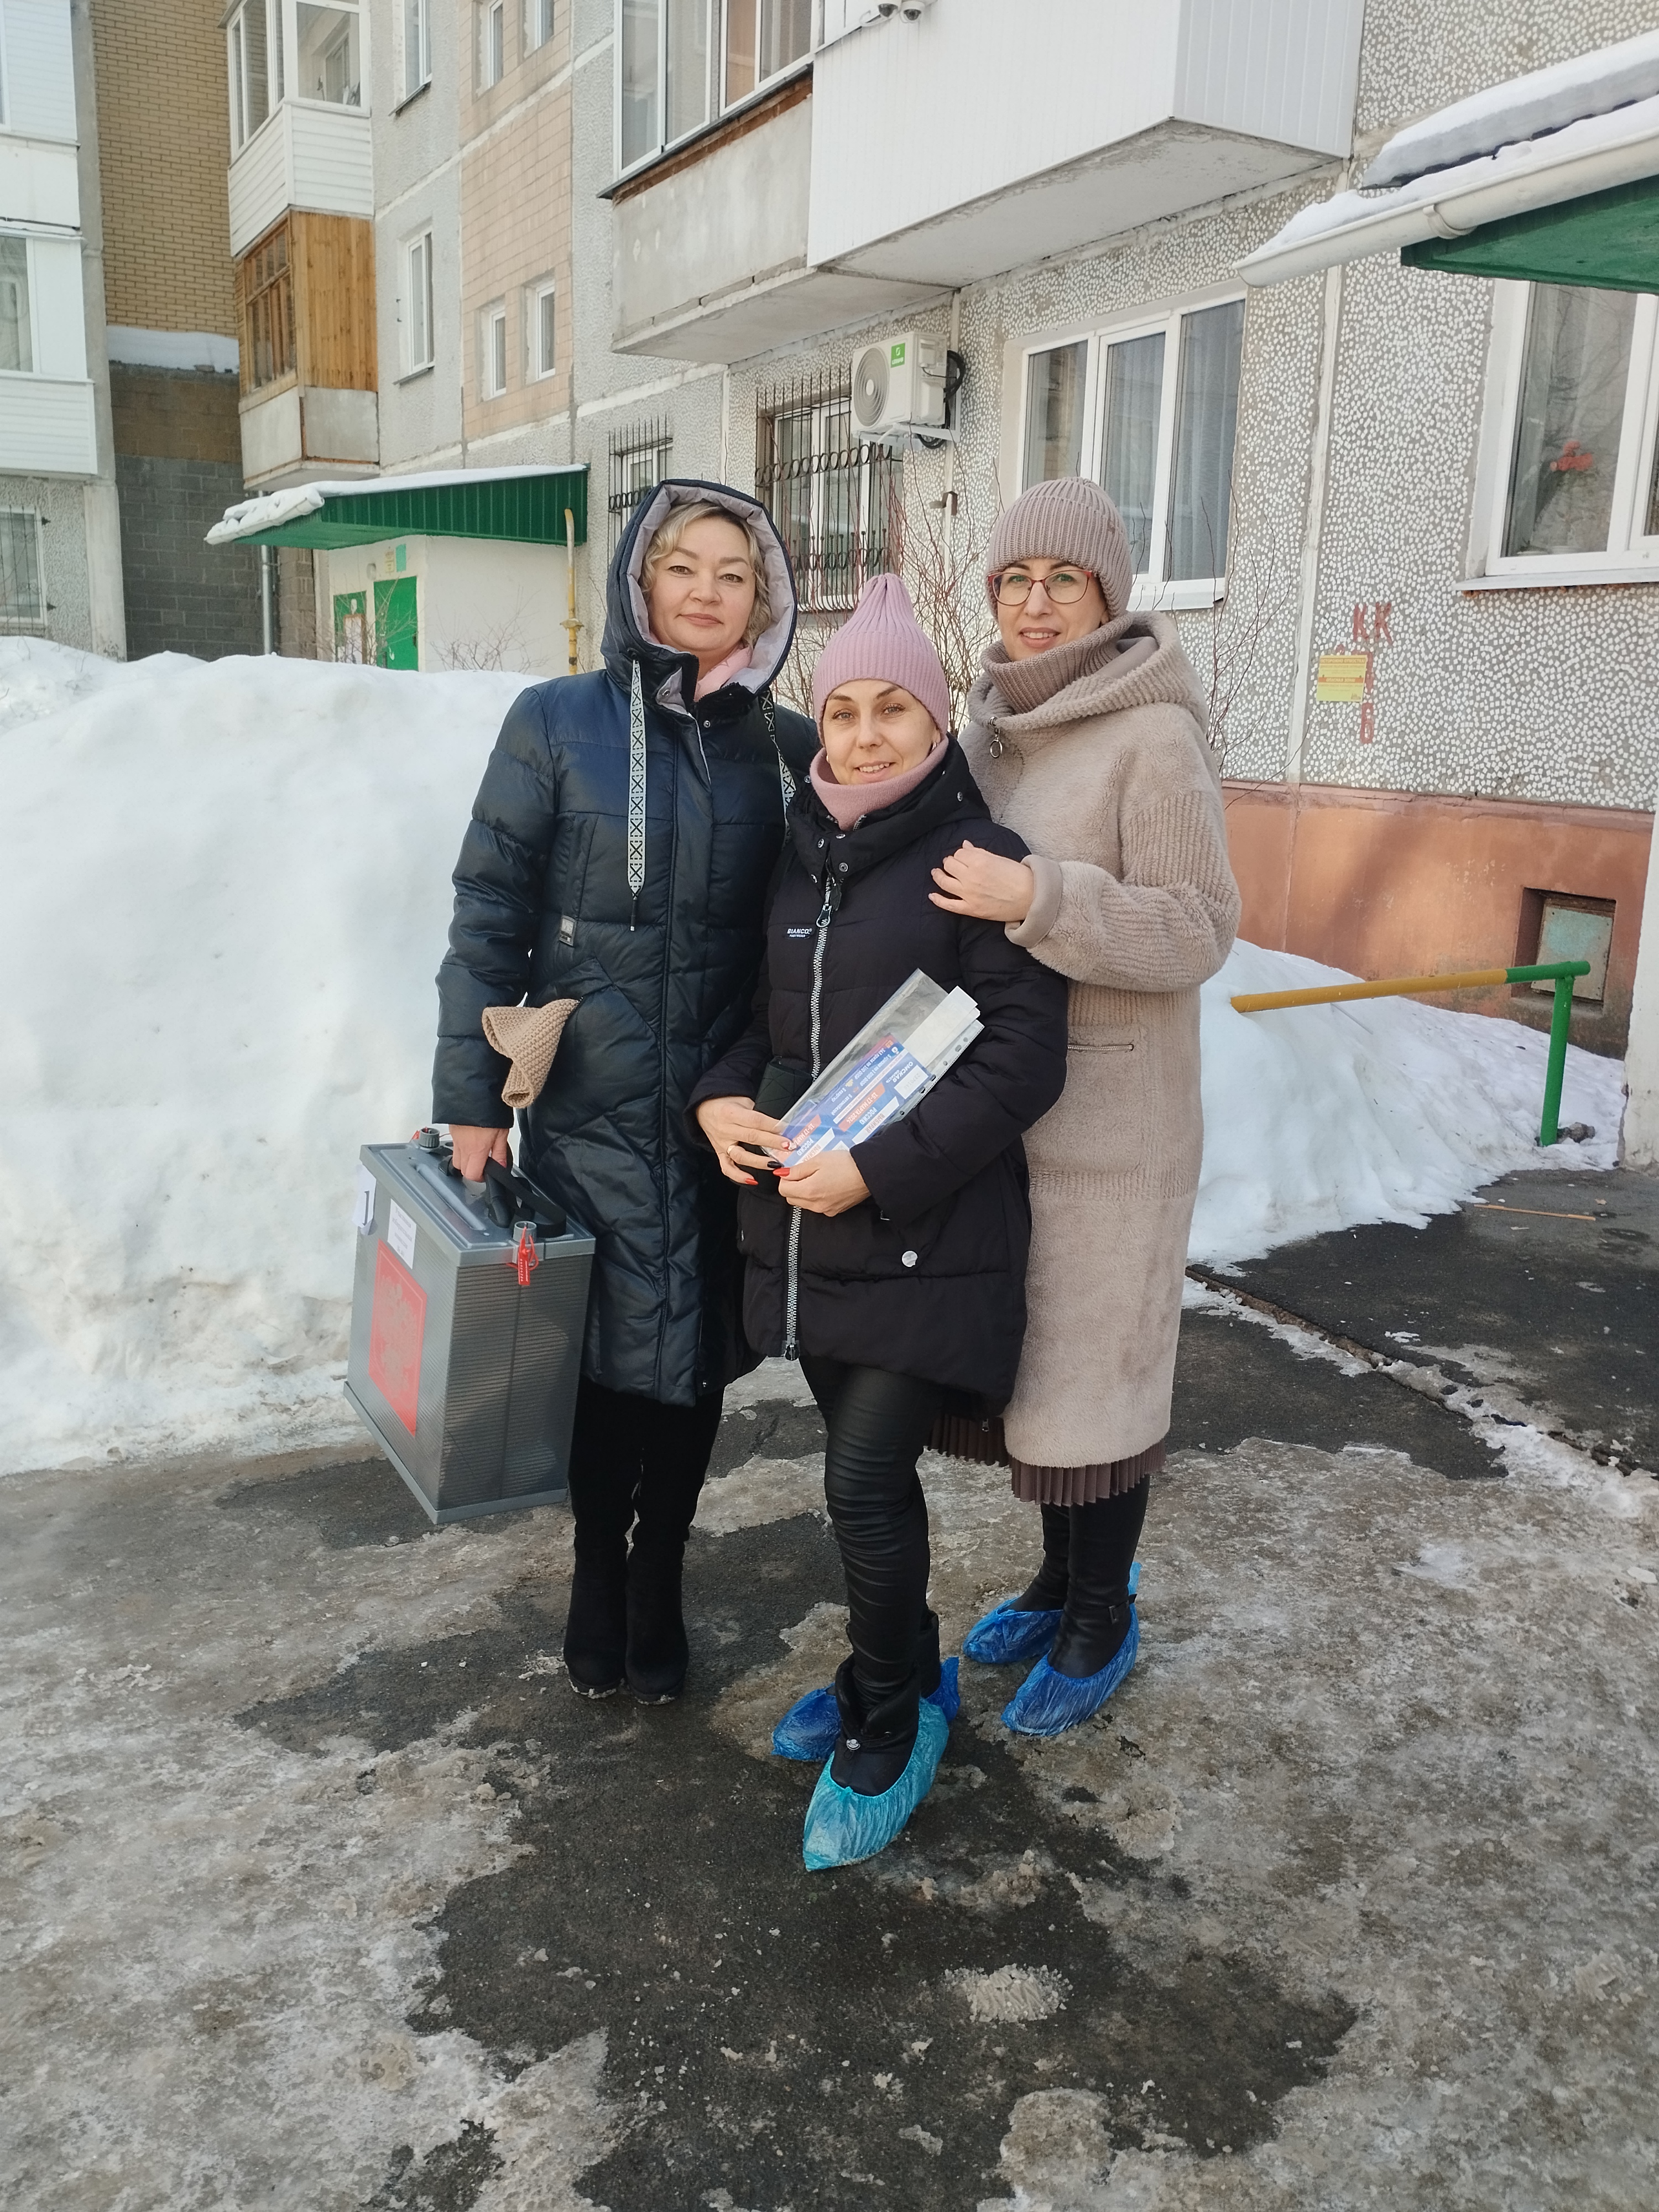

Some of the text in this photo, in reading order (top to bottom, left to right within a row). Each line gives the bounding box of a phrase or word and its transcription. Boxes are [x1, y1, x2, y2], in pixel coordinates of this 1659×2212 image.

[891, 1060, 914, 1083] ОМСКАЯ
[865, 1091, 878, 1104] 15-17
[854, 1101, 868, 1115] МАРТА
[858, 1106, 877, 1125] РОССИЮ
[846, 1113, 857, 1124] 2024
[864, 1112, 885, 1133] ВЫБИРАЙ
[802, 1123, 815, 1135] 15-17
[796, 1138, 813, 1156] РОССИЮ
